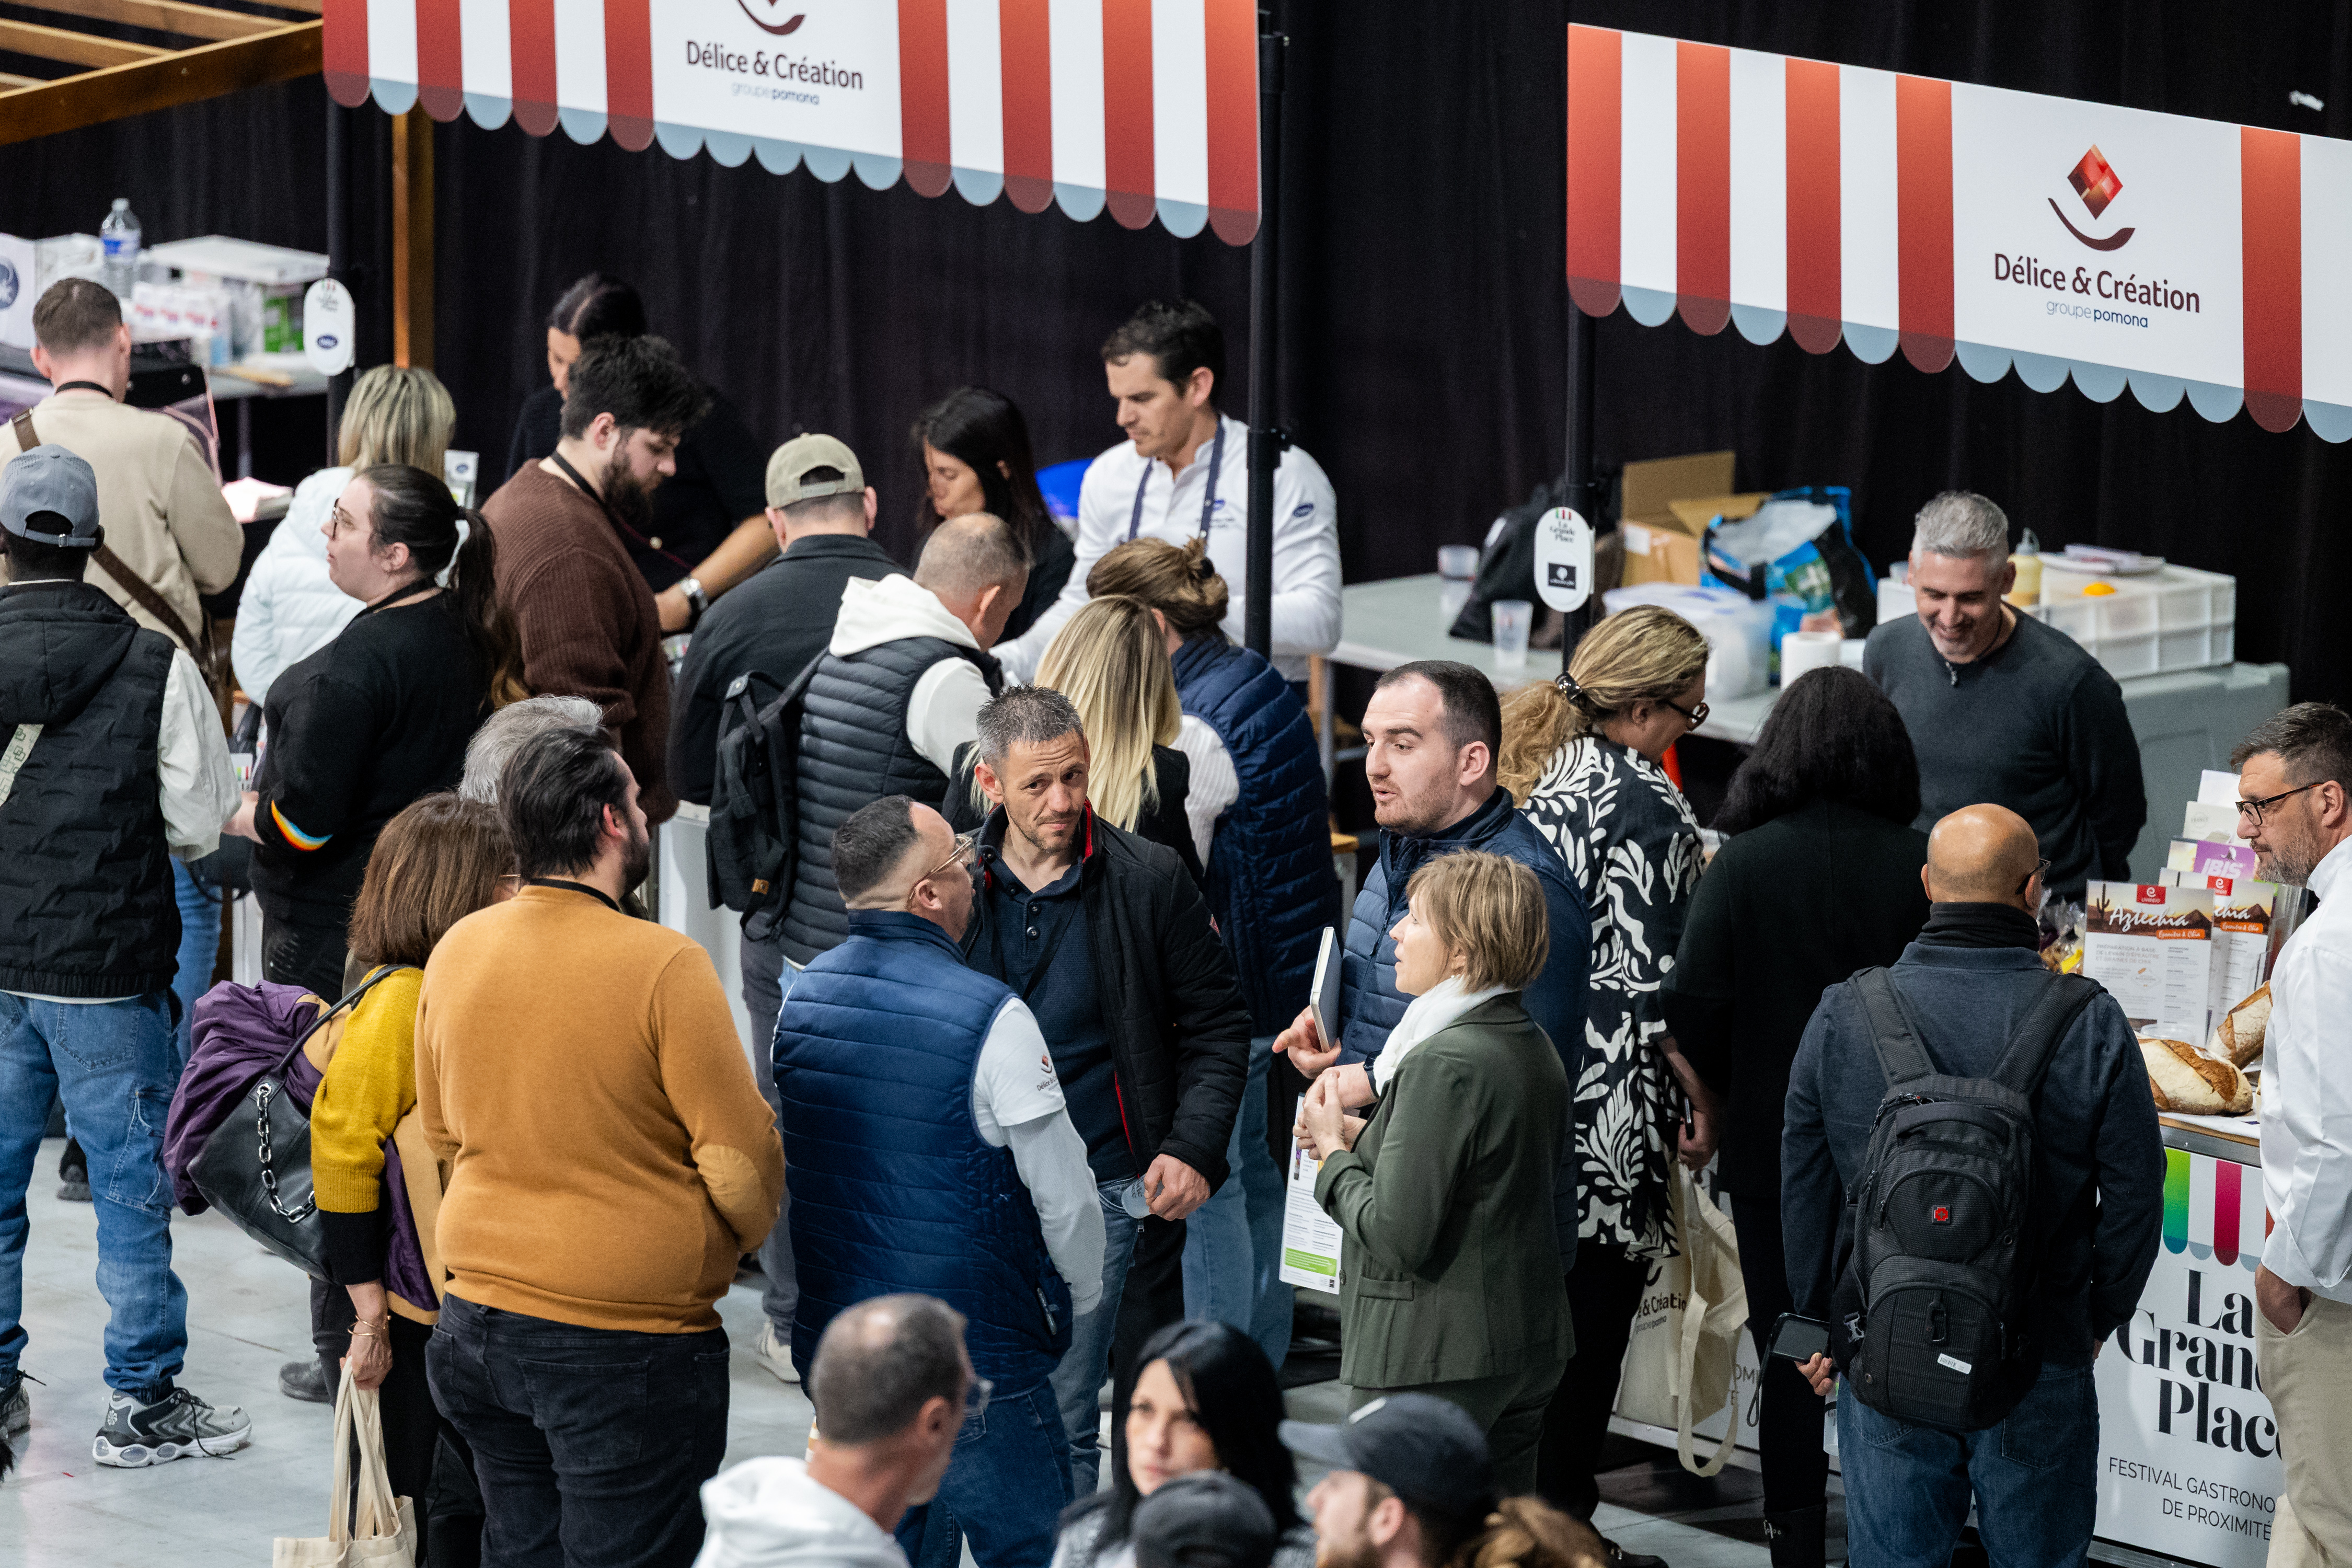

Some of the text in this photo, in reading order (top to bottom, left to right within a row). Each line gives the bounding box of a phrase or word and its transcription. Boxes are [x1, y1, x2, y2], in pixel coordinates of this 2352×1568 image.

[687, 40, 863, 90] Délice & Création
[771, 87, 820, 105] pomona
[1994, 252, 2200, 313] Délice & Création
[2046, 301, 2148, 328] groupe pomona
[2201, 858, 2244, 880] IBIS
[2109, 904, 2189, 932] Aztechia
[2213, 900, 2251, 920] chia
[1651, 1293, 1687, 1313] Créatio
[2182, 1267, 2255, 1339] La
[2116, 1308, 2265, 1392] Gran
[2153, 1376, 2282, 1461] Plac
[2108, 1457, 2276, 1514] FESTIVAL GASTRONO
[2162, 1498, 2272, 1541] DE PROXIMITÉ
